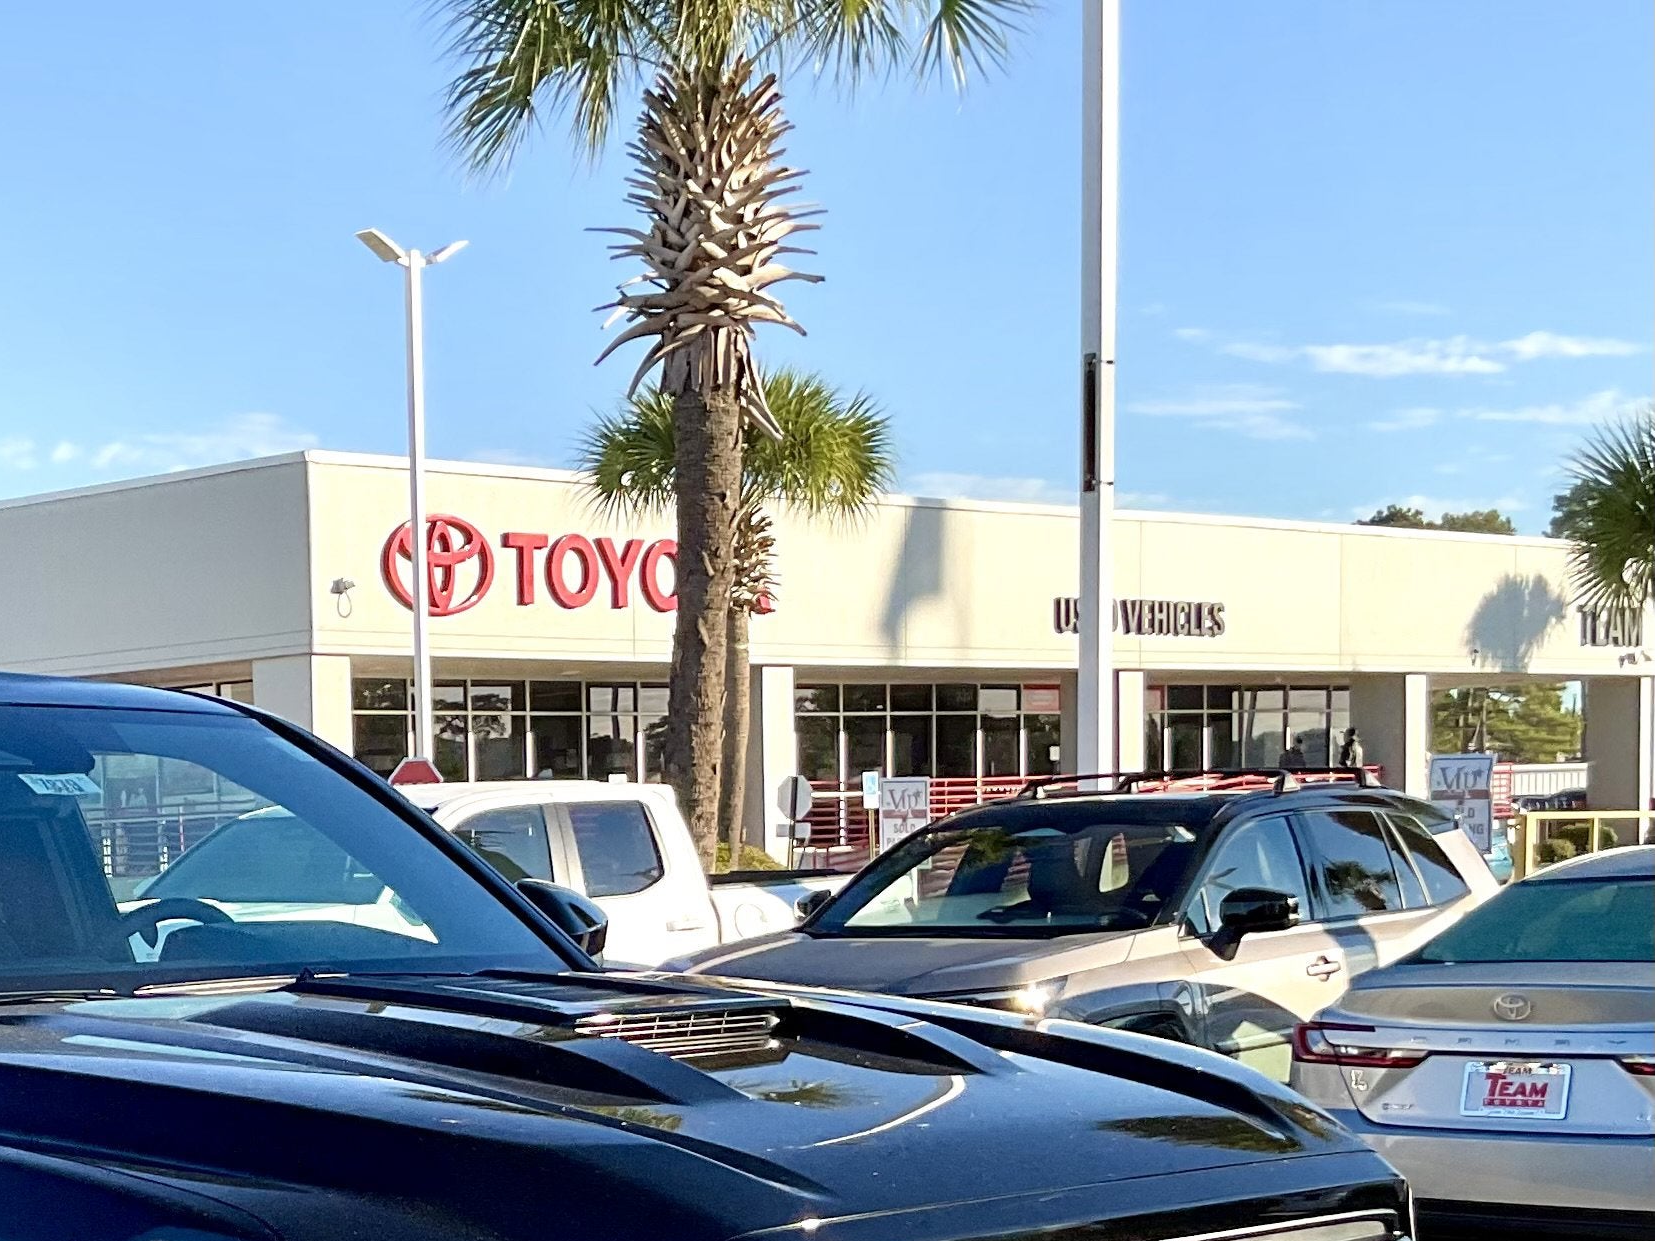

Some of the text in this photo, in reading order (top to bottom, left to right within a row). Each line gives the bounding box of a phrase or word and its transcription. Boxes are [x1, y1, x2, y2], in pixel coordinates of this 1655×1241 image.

[500, 532, 775, 613] TOYO
[1120, 599, 1225, 637] VEHICLES
[1485, 1072, 1549, 1098] TEAM
